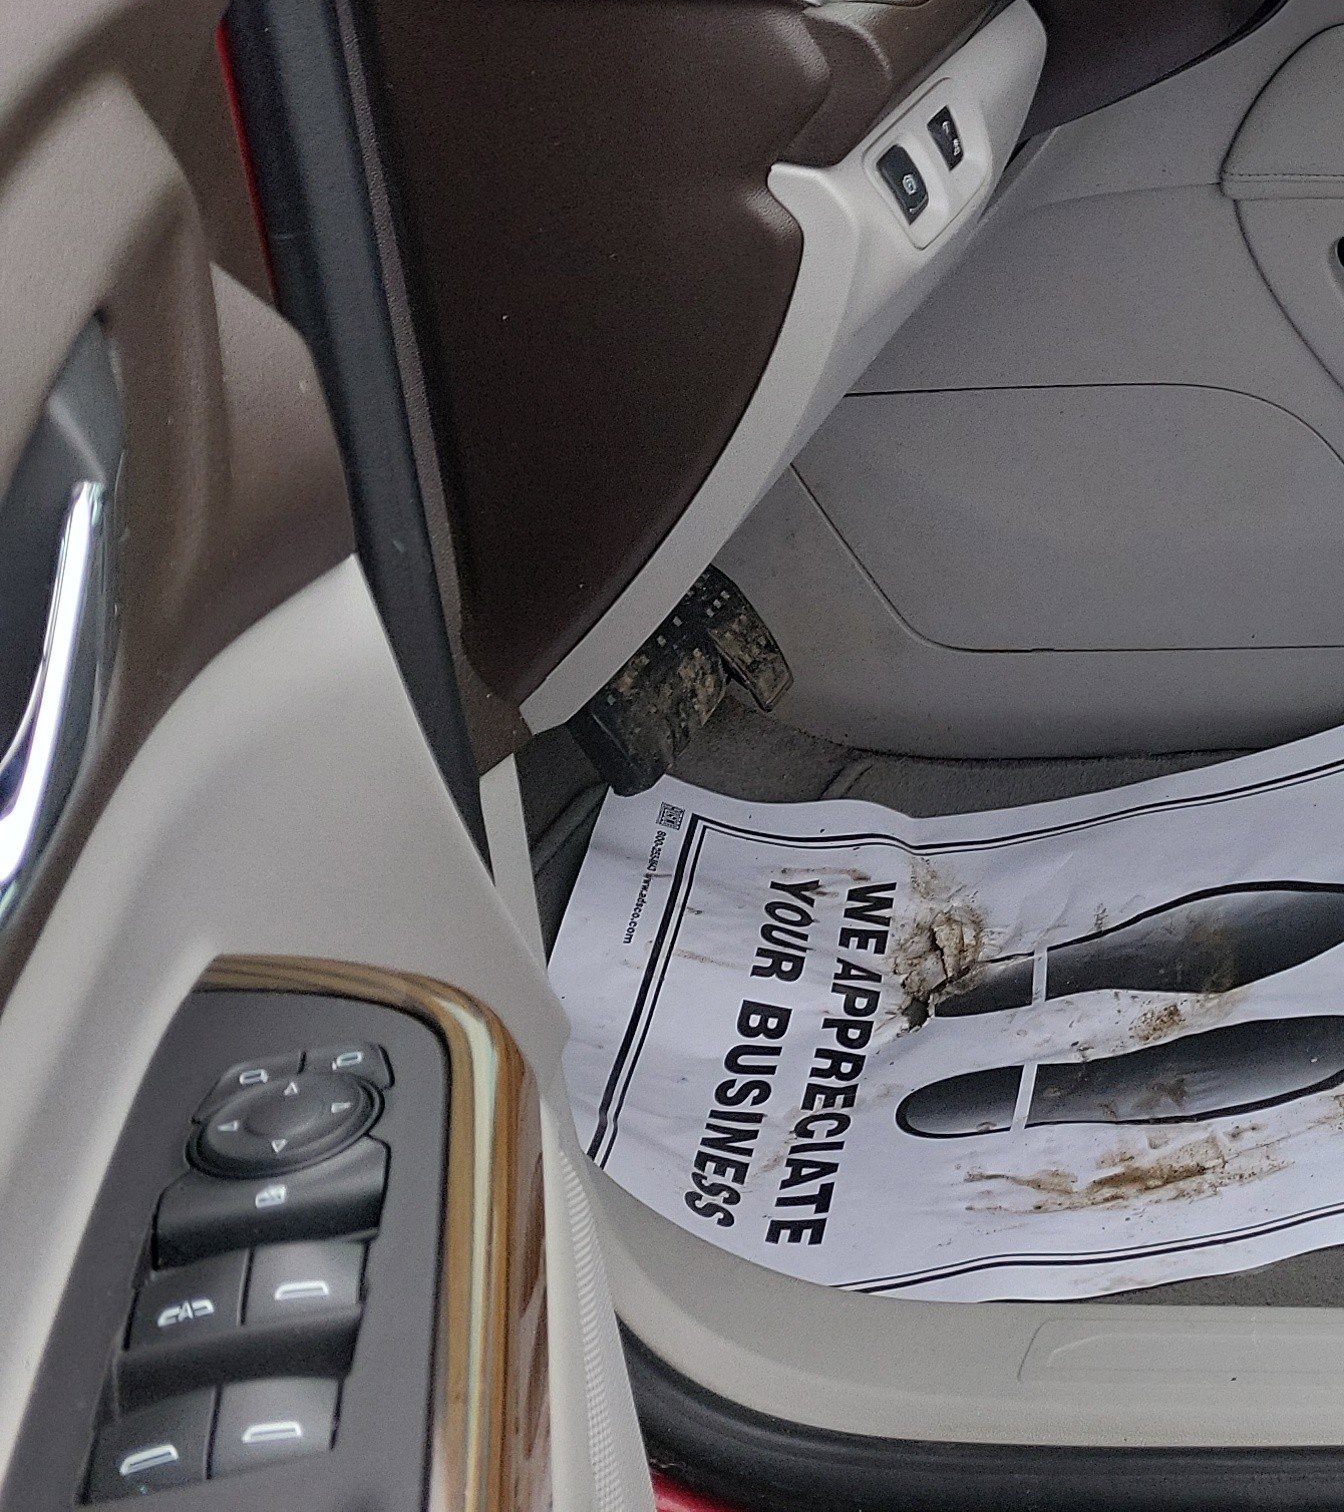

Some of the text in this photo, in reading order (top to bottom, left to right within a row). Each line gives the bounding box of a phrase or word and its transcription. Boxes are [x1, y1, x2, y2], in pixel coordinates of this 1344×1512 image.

[684, 879, 820, 1228] YOUR BUSINESS
[765, 881, 897, 1246] WE APPRECIATE
